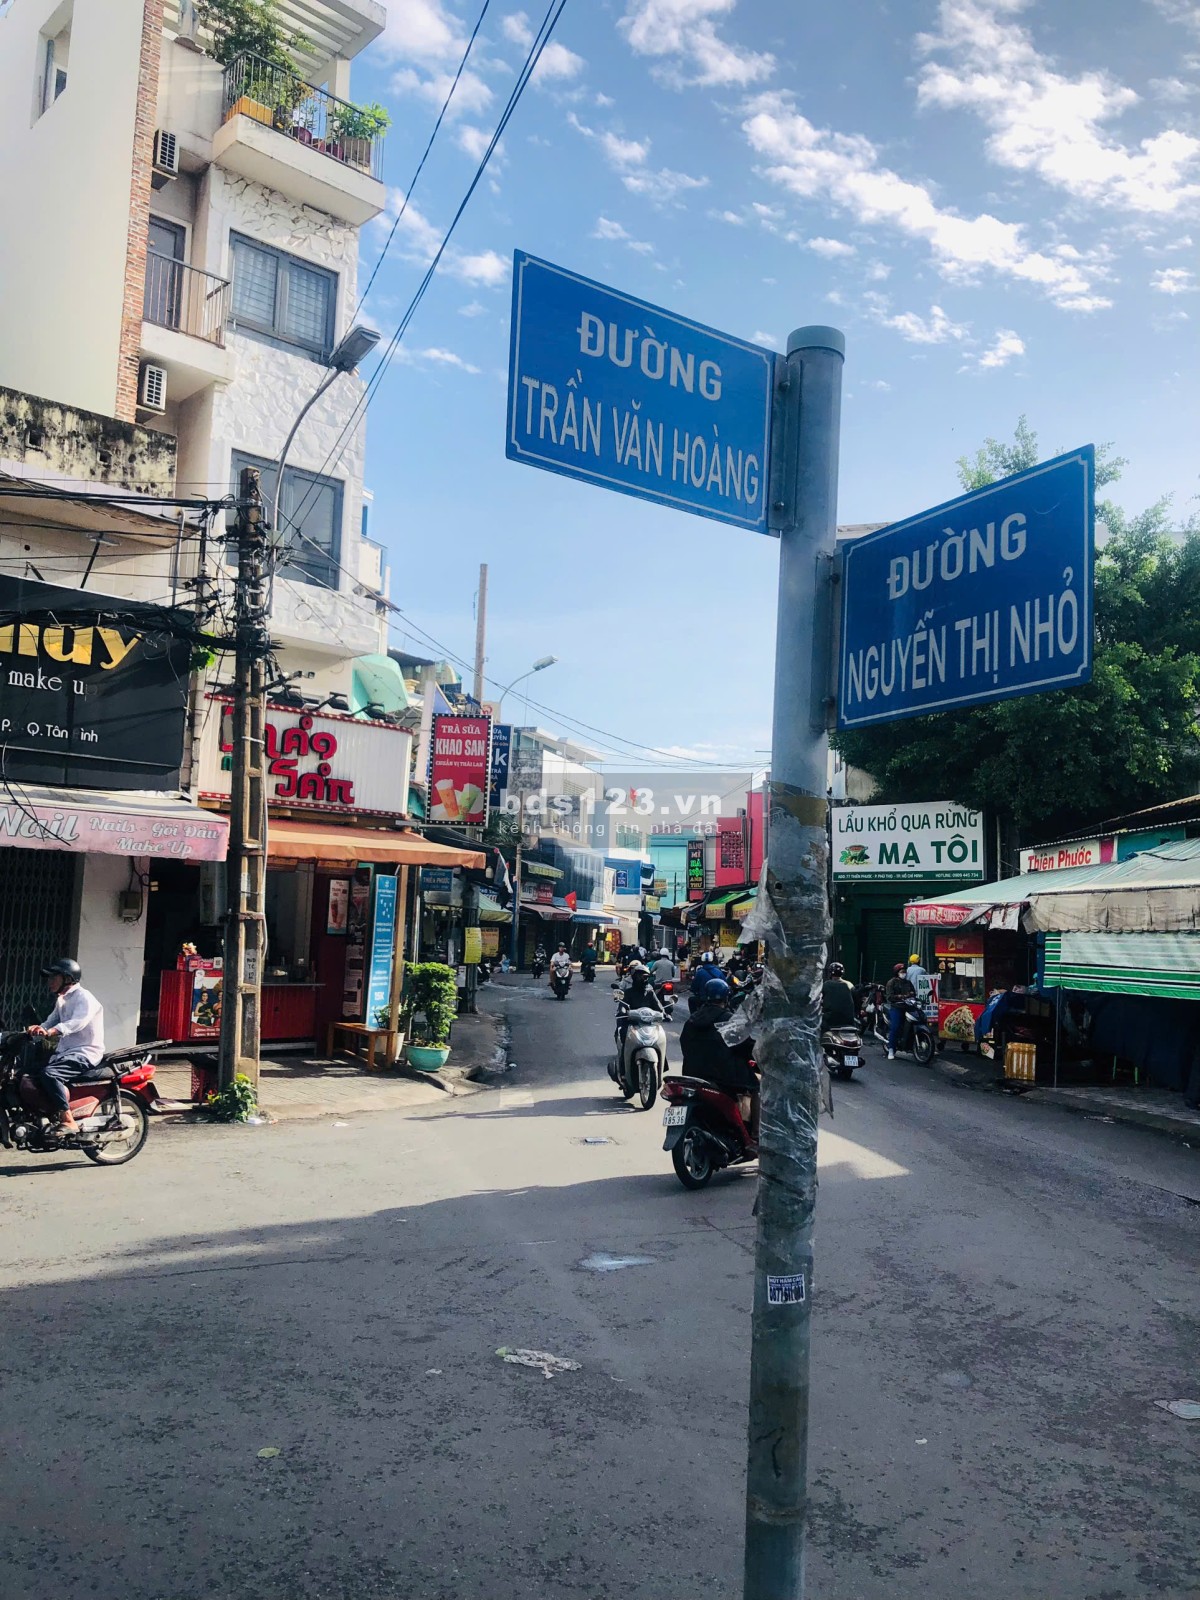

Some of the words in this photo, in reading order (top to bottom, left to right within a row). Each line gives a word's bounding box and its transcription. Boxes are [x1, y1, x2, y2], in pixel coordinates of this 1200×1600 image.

[577, 311, 722, 401] ĐƯỜNG
[522, 369, 601, 457] TRẦN
[613, 399, 663, 476] VĂN
[672, 424, 758, 504] HOÀNG
[887, 512, 1026, 600] ĐƯỜNG
[848, 608, 946, 704] NGUYỄN
[955, 610, 999, 684] THỊ
[1010, 566, 1078, 667] NHỎ
[8, 667, 62, 691] make
[441, 724, 460, 734] TRÀ
[462, 724, 481, 734] SỮA
[435, 738, 463, 756] KHAO
[464, 739, 485, 756] SAN
[89, 816, 137, 833] Nails
[838, 810, 864, 833] LẨU
[868, 808, 897, 832] KHỔ
[901, 814, 931, 832] QUA
[936, 809, 978, 829] RỪNG
[116, 837, 164, 854] Make
[167, 841, 193, 857] Up
[878, 842, 920, 867] MẠ
[931, 833, 978, 863] TÔI
[1028, 852, 1054, 870] Thiên
[1058, 845, 1092, 868] Phước
